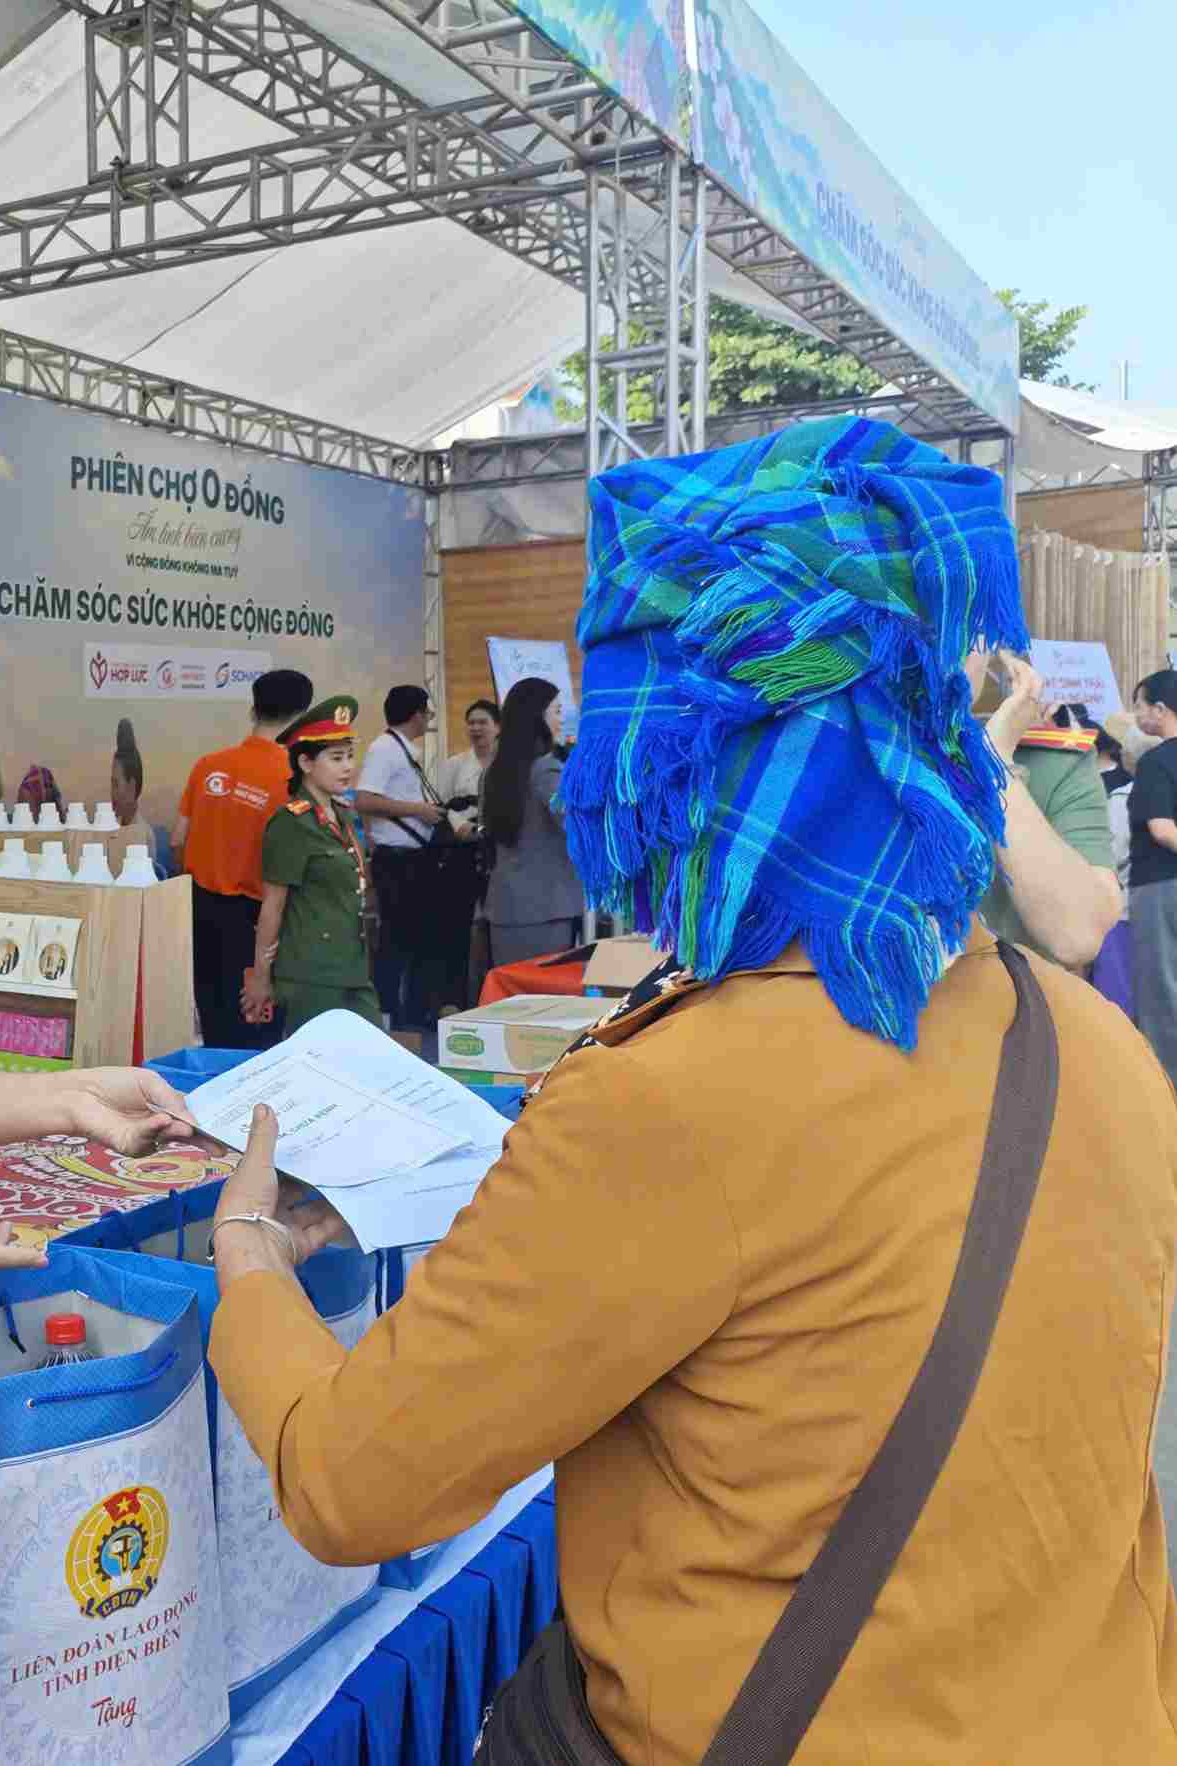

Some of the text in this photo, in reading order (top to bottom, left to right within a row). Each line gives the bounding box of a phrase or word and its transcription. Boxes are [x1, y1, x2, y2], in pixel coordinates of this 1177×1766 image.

[71, 451, 144, 496] PHIÊN
[148, 467, 197, 513] CHỢ
[224, 473, 285, 525] ĐỒNG
[76, 583, 122, 623] SÓC
[127, 588, 169, 627] SỨC
[230, 599, 282, 640] CỘNG
[286, 599, 334, 638] ĐỒNG
[11, 1585, 198, 1684] LIÊN ĐOÀN LAO ĐỘNG
[95, 1646, 137, 1676] ĐIỆN
[144, 1627, 181, 1658] BIÊN
[91, 1697, 142, 1728] Tặng
